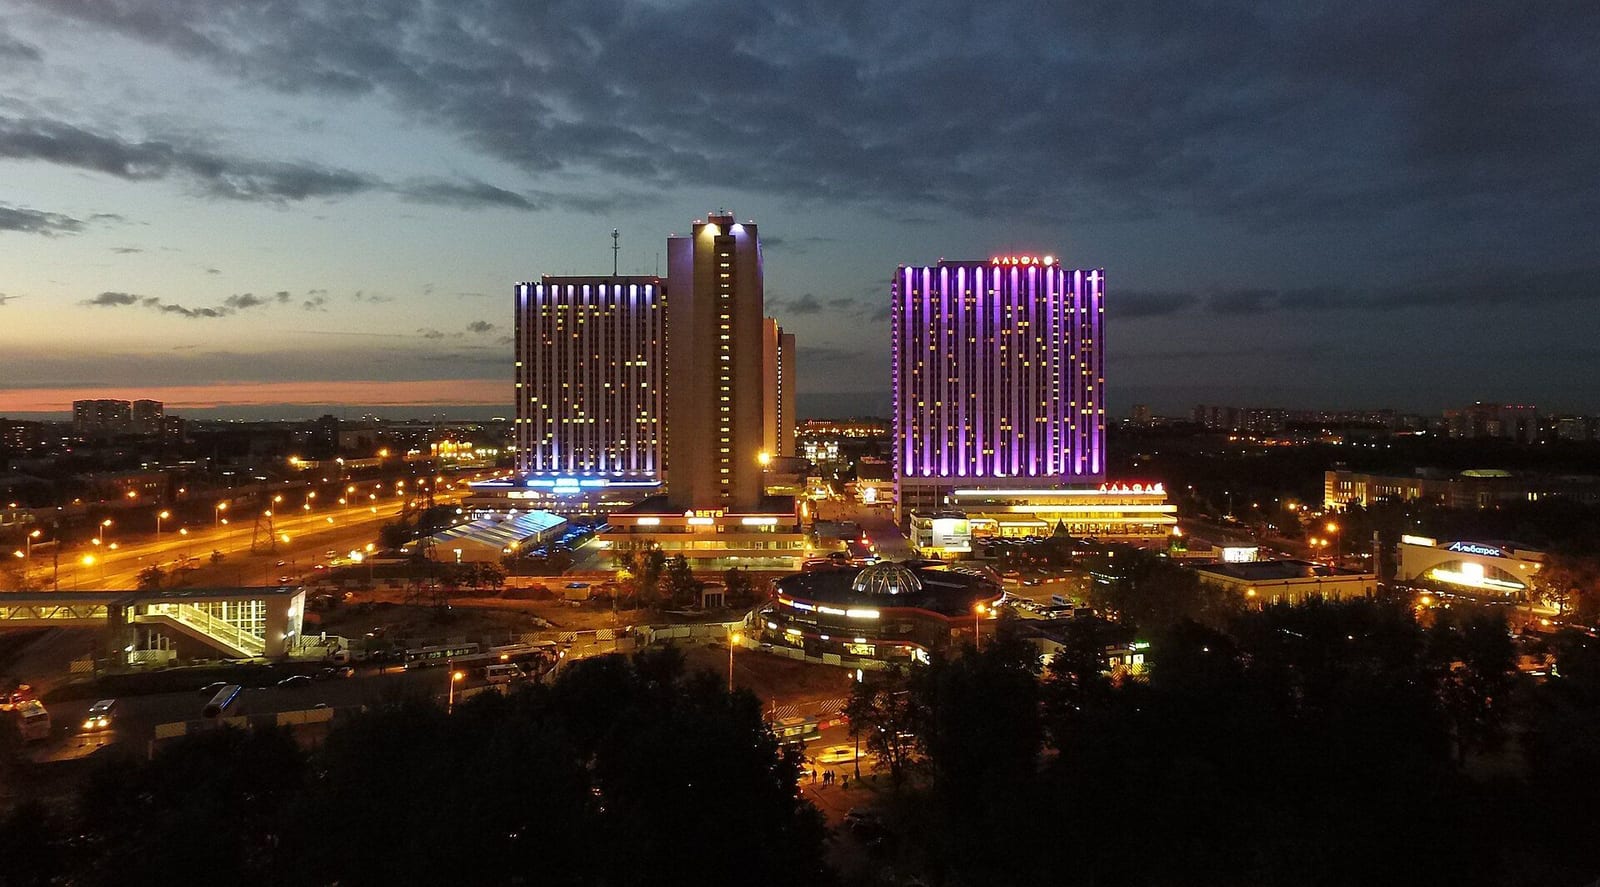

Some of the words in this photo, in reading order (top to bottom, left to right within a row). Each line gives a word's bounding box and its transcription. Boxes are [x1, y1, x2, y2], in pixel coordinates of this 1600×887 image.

[992, 256, 1039, 265] АЛЬФА
[1100, 483, 1153, 494] АЛЬФА
[1449, 541, 1500, 556] Альбатрос
